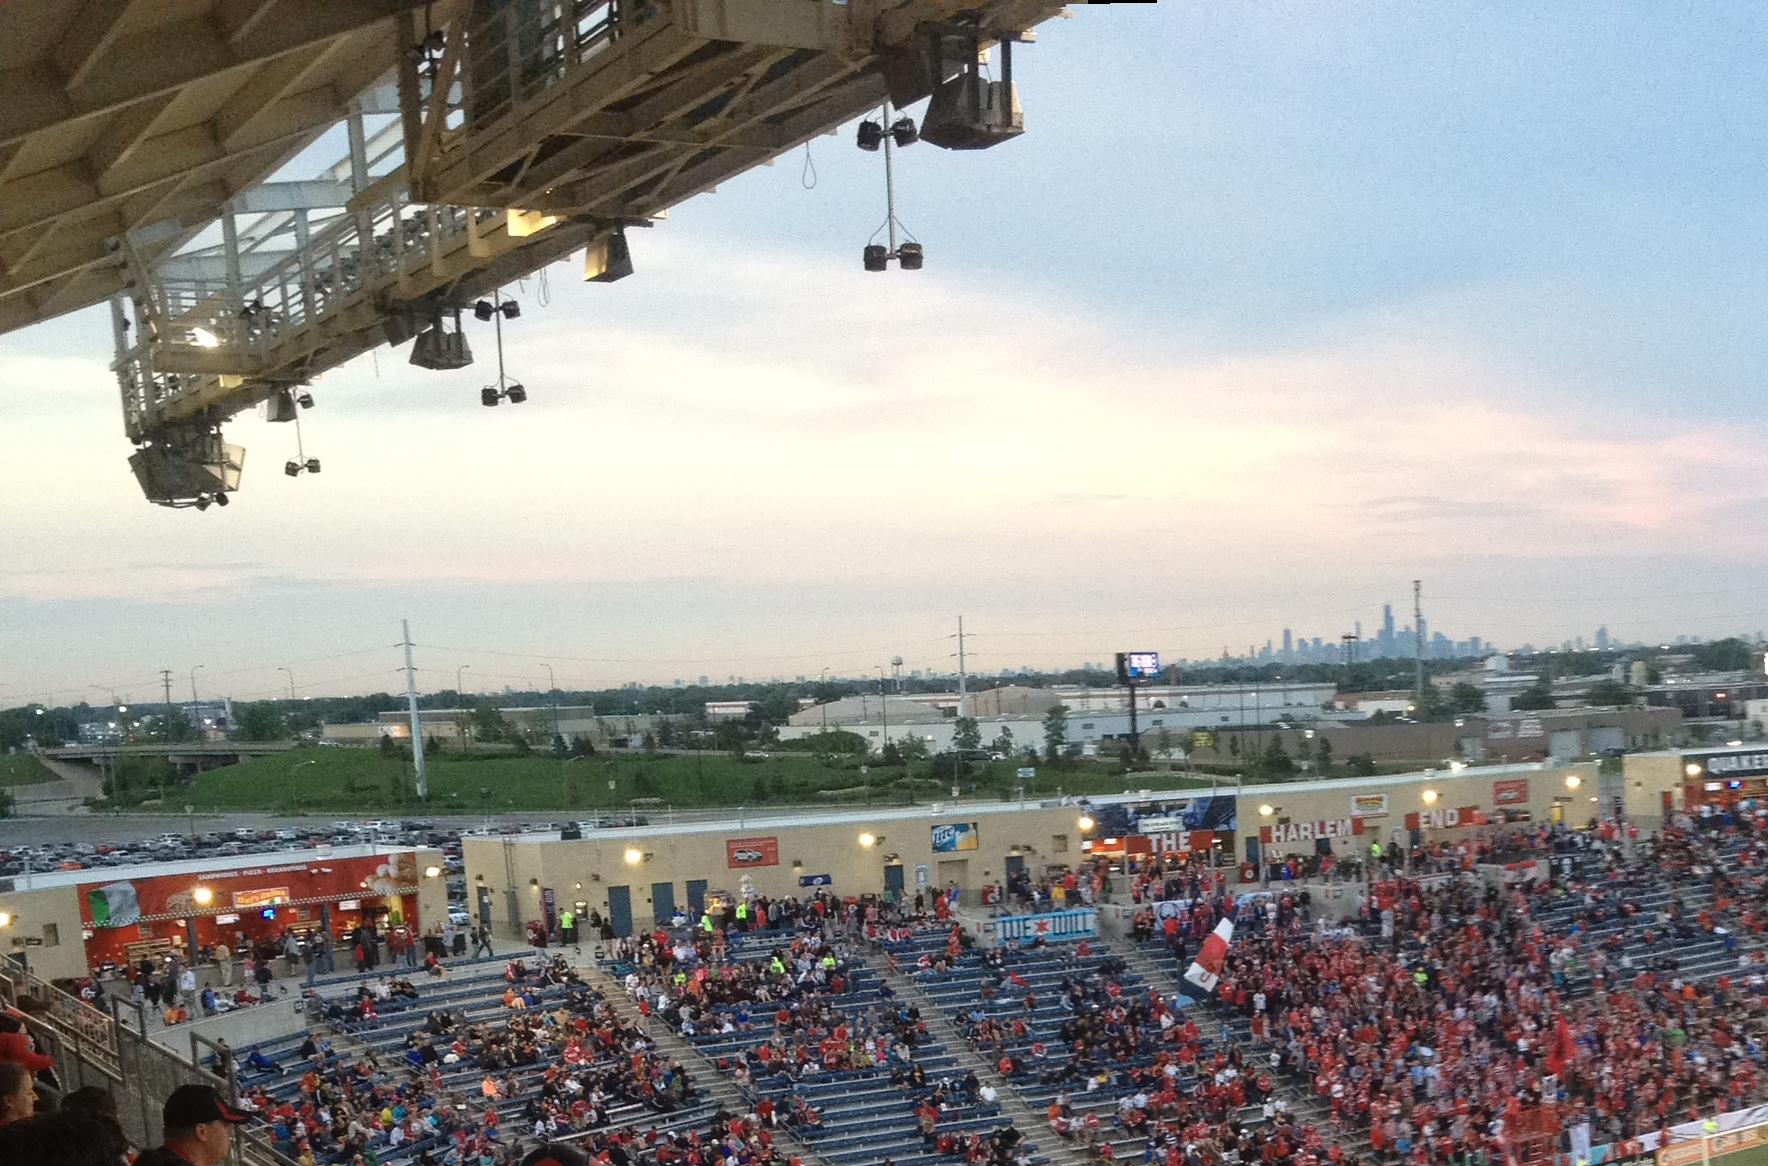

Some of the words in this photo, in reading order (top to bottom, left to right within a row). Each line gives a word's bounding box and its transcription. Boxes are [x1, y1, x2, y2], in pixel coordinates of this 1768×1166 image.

[1418, 808, 1459, 829] END
[1149, 831, 1191, 853] THE
[1271, 818, 1351, 843] HARLEM
[1053, 912, 1091, 936] WILL
